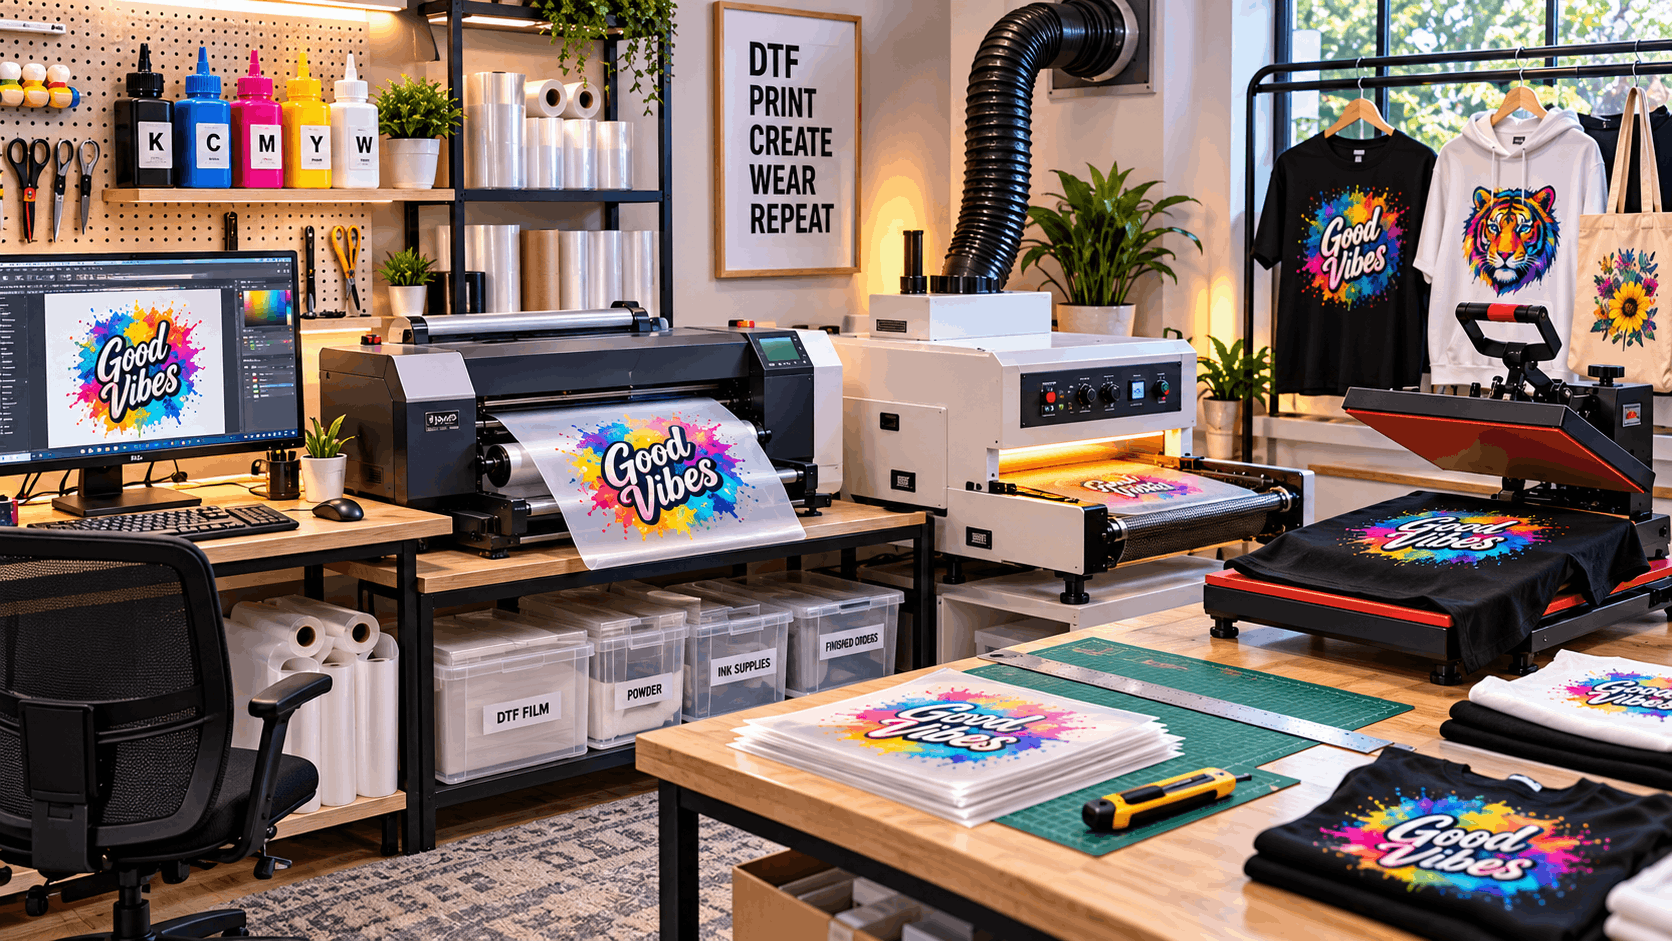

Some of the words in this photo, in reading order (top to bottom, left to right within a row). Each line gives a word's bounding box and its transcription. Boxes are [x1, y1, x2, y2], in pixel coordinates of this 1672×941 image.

[749, 41, 800, 79] DTF
[749, 84, 817, 118] PRINT
[148, 132, 165, 151] K
[206, 133, 221, 152] C
[259, 134, 275, 152] M
[310, 135, 323, 153] Y
[355, 136, 373, 153] W
[749, 124, 833, 157] CREATE
[749, 163, 816, 195] WEAR
[750, 203, 834, 234] REPEAT
[1320, 205, 1382, 258] Good
[1321, 244, 1387, 291] Vibes
[96, 320, 170, 383] Good
[99, 363, 179, 420] Vibes
[603, 425, 692, 488] Good
[619, 458, 719, 522] Vibes
[1382, 532, 1506, 550] Vibes
[1397, 516, 1519, 535] Good
[718, 665, 732, 677] INK
[734, 657, 771, 675] SUPPLIES
[627, 683, 662, 701] POWDER
[496, 707, 519, 724] DTF
[522, 702, 550, 719] FILM
[897, 702, 1047, 733] Good
[867, 718, 1019, 752] Vibes
[1385, 813, 1541, 853] Good
[1376, 841, 1535, 881] Vibes
